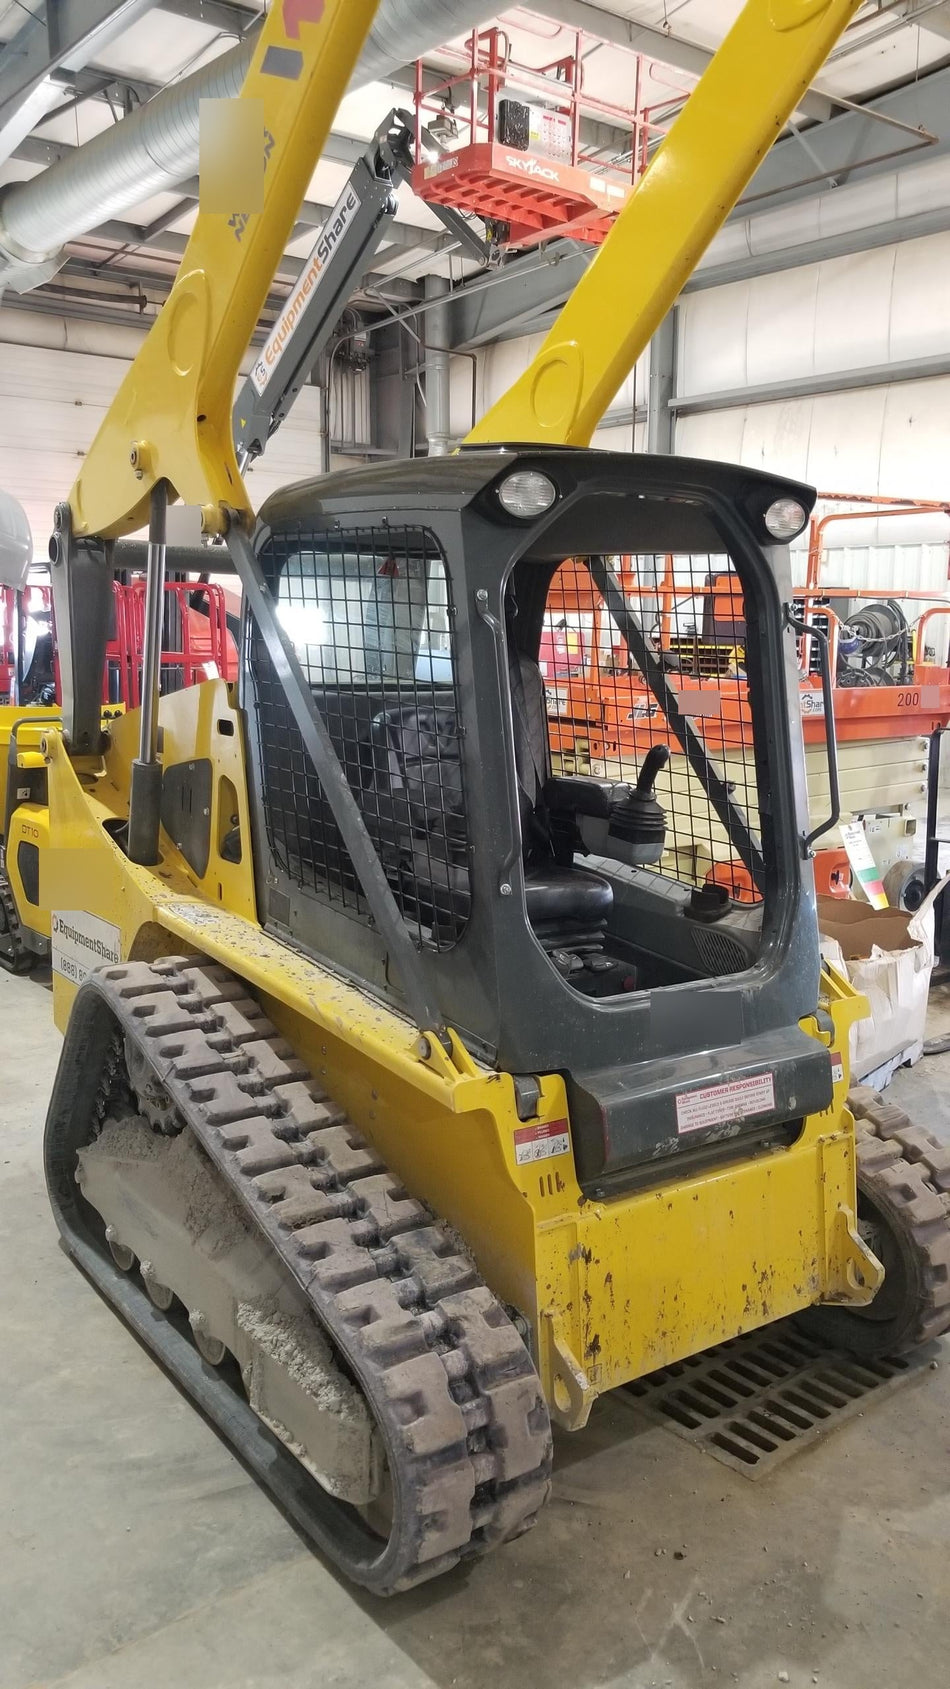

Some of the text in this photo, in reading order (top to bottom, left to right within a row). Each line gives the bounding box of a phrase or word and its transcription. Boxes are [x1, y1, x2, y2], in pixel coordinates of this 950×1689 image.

[506, 155, 560, 181] SKYJACK
[264, 192, 357, 365] EquipmentShare
[897, 692, 919, 707] 200
[59, 919, 119, 963] EquipmentShare
[60, 957, 78, 979] (888)
[700, 1088, 729, 1100] CUSTOMER
[730, 1077, 771, 1092] RESPONSIBILITY
